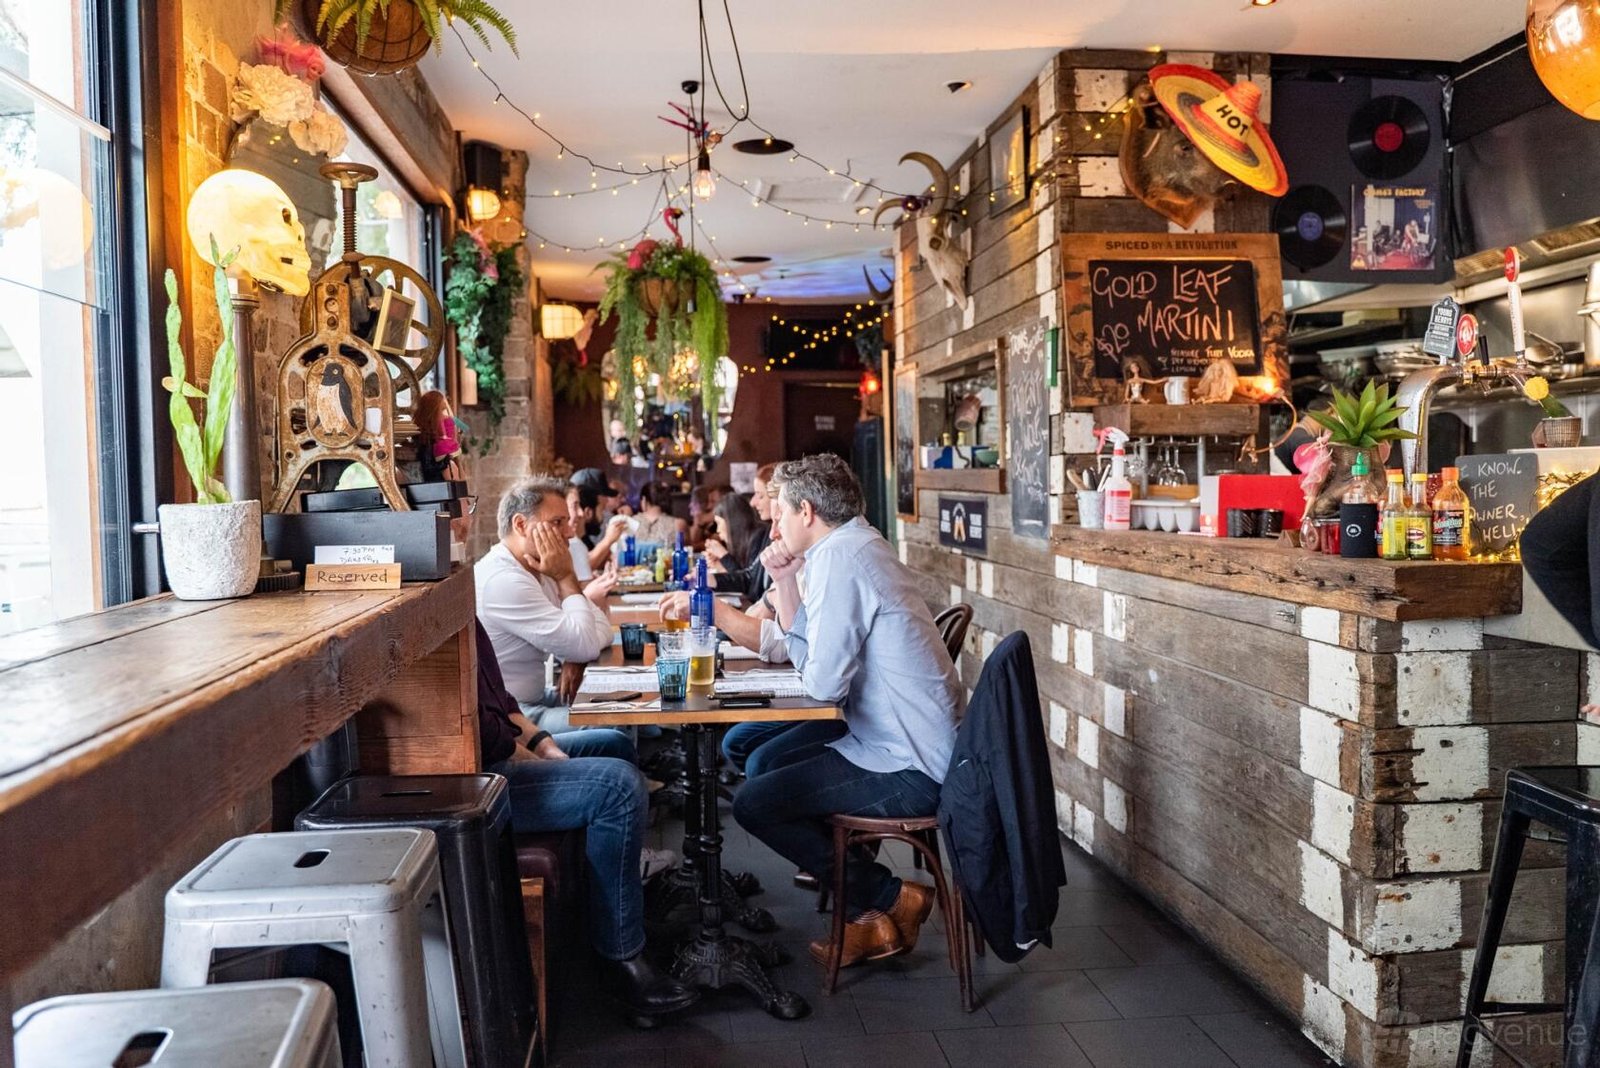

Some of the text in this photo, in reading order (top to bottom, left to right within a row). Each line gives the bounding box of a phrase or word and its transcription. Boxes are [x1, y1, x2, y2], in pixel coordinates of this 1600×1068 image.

[1216, 104, 1249, 136] HOT
[1105, 240, 1149, 250] SPICED
[1151, 241, 1163, 250] BY
[1175, 240, 1238, 250] REVOLUTION
[1093, 264, 1234, 308] GOLD LEAF
[1137, 301, 1235, 347] MARTINI
[1096, 322, 1130, 363] $20
[1471, 480, 1498, 500] THE
[317, 569, 388, 583] Reserved
